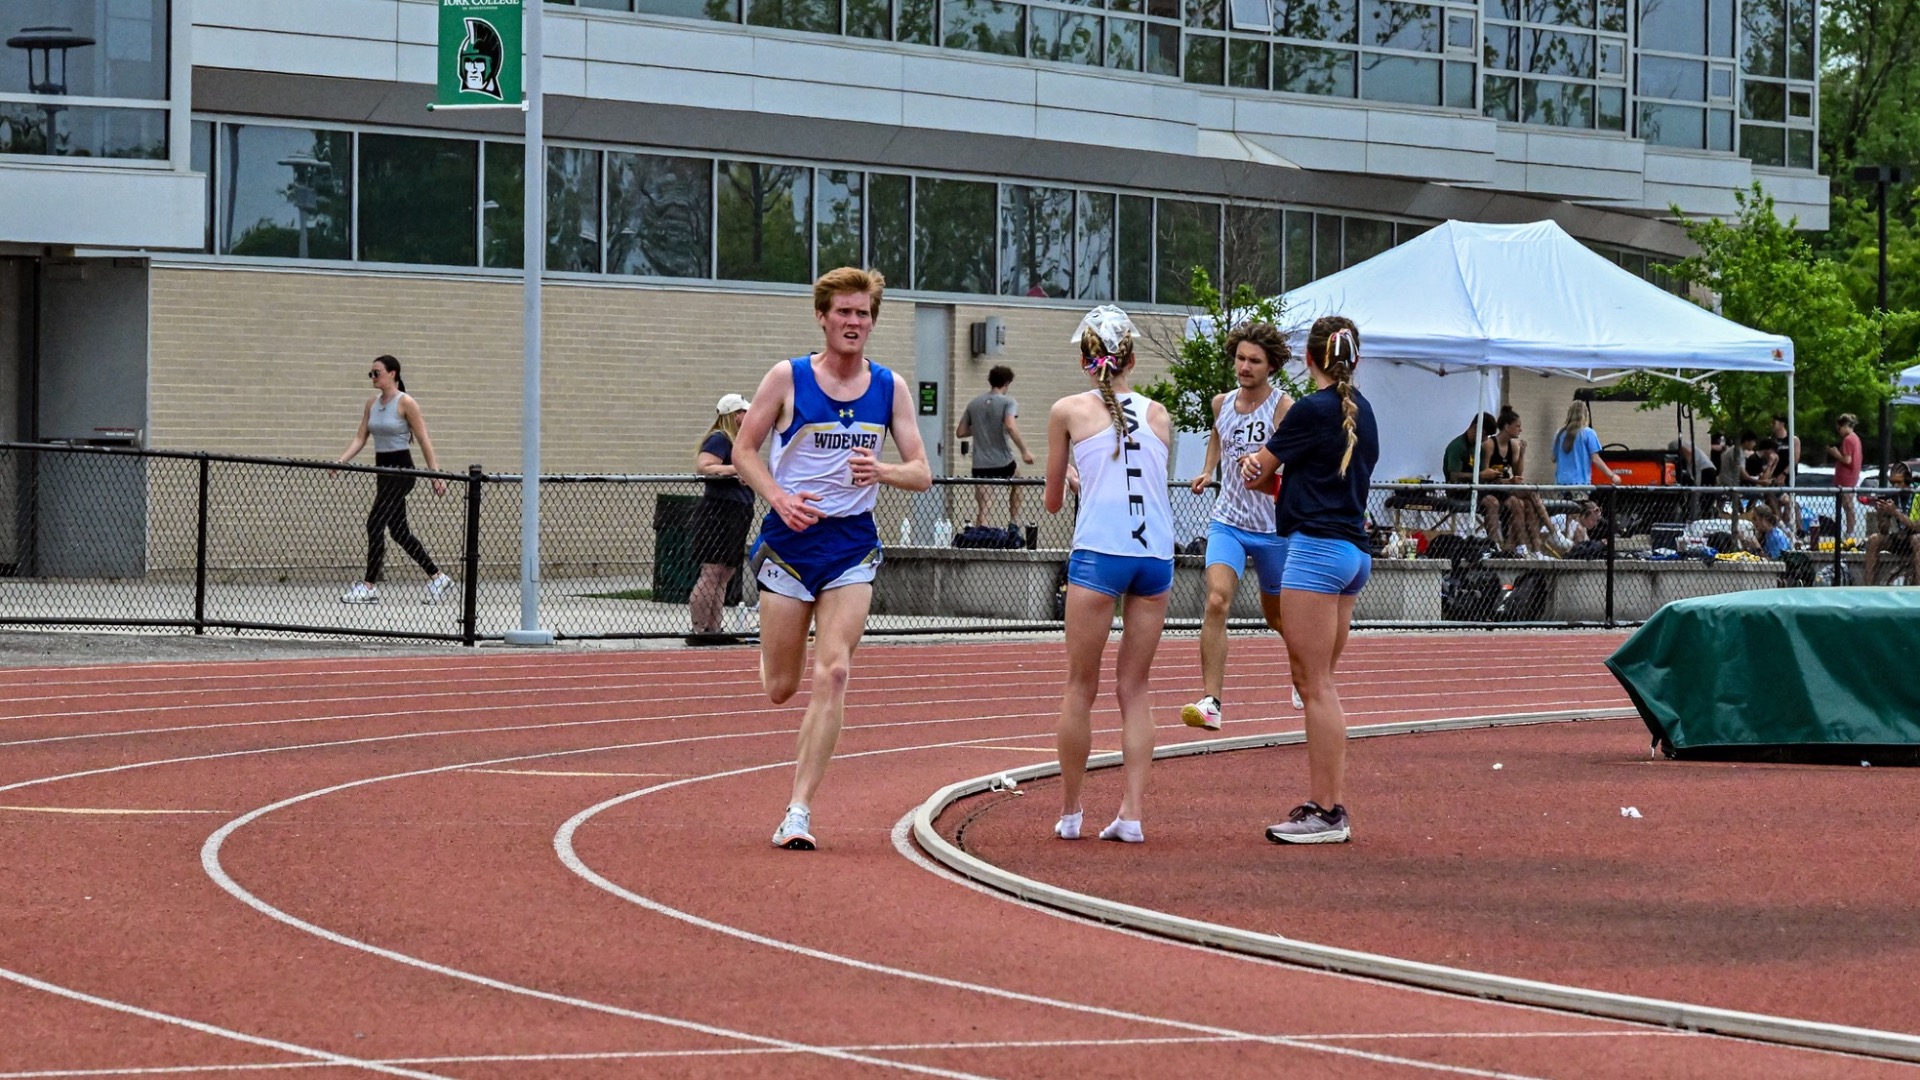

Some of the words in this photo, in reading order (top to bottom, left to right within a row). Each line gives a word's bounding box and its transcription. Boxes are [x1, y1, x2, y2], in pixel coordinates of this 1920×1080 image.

[814, 432, 878, 449] WIDENER
[1246, 421, 1266, 442] 13
[1120, 397, 1148, 550] VALLEY
